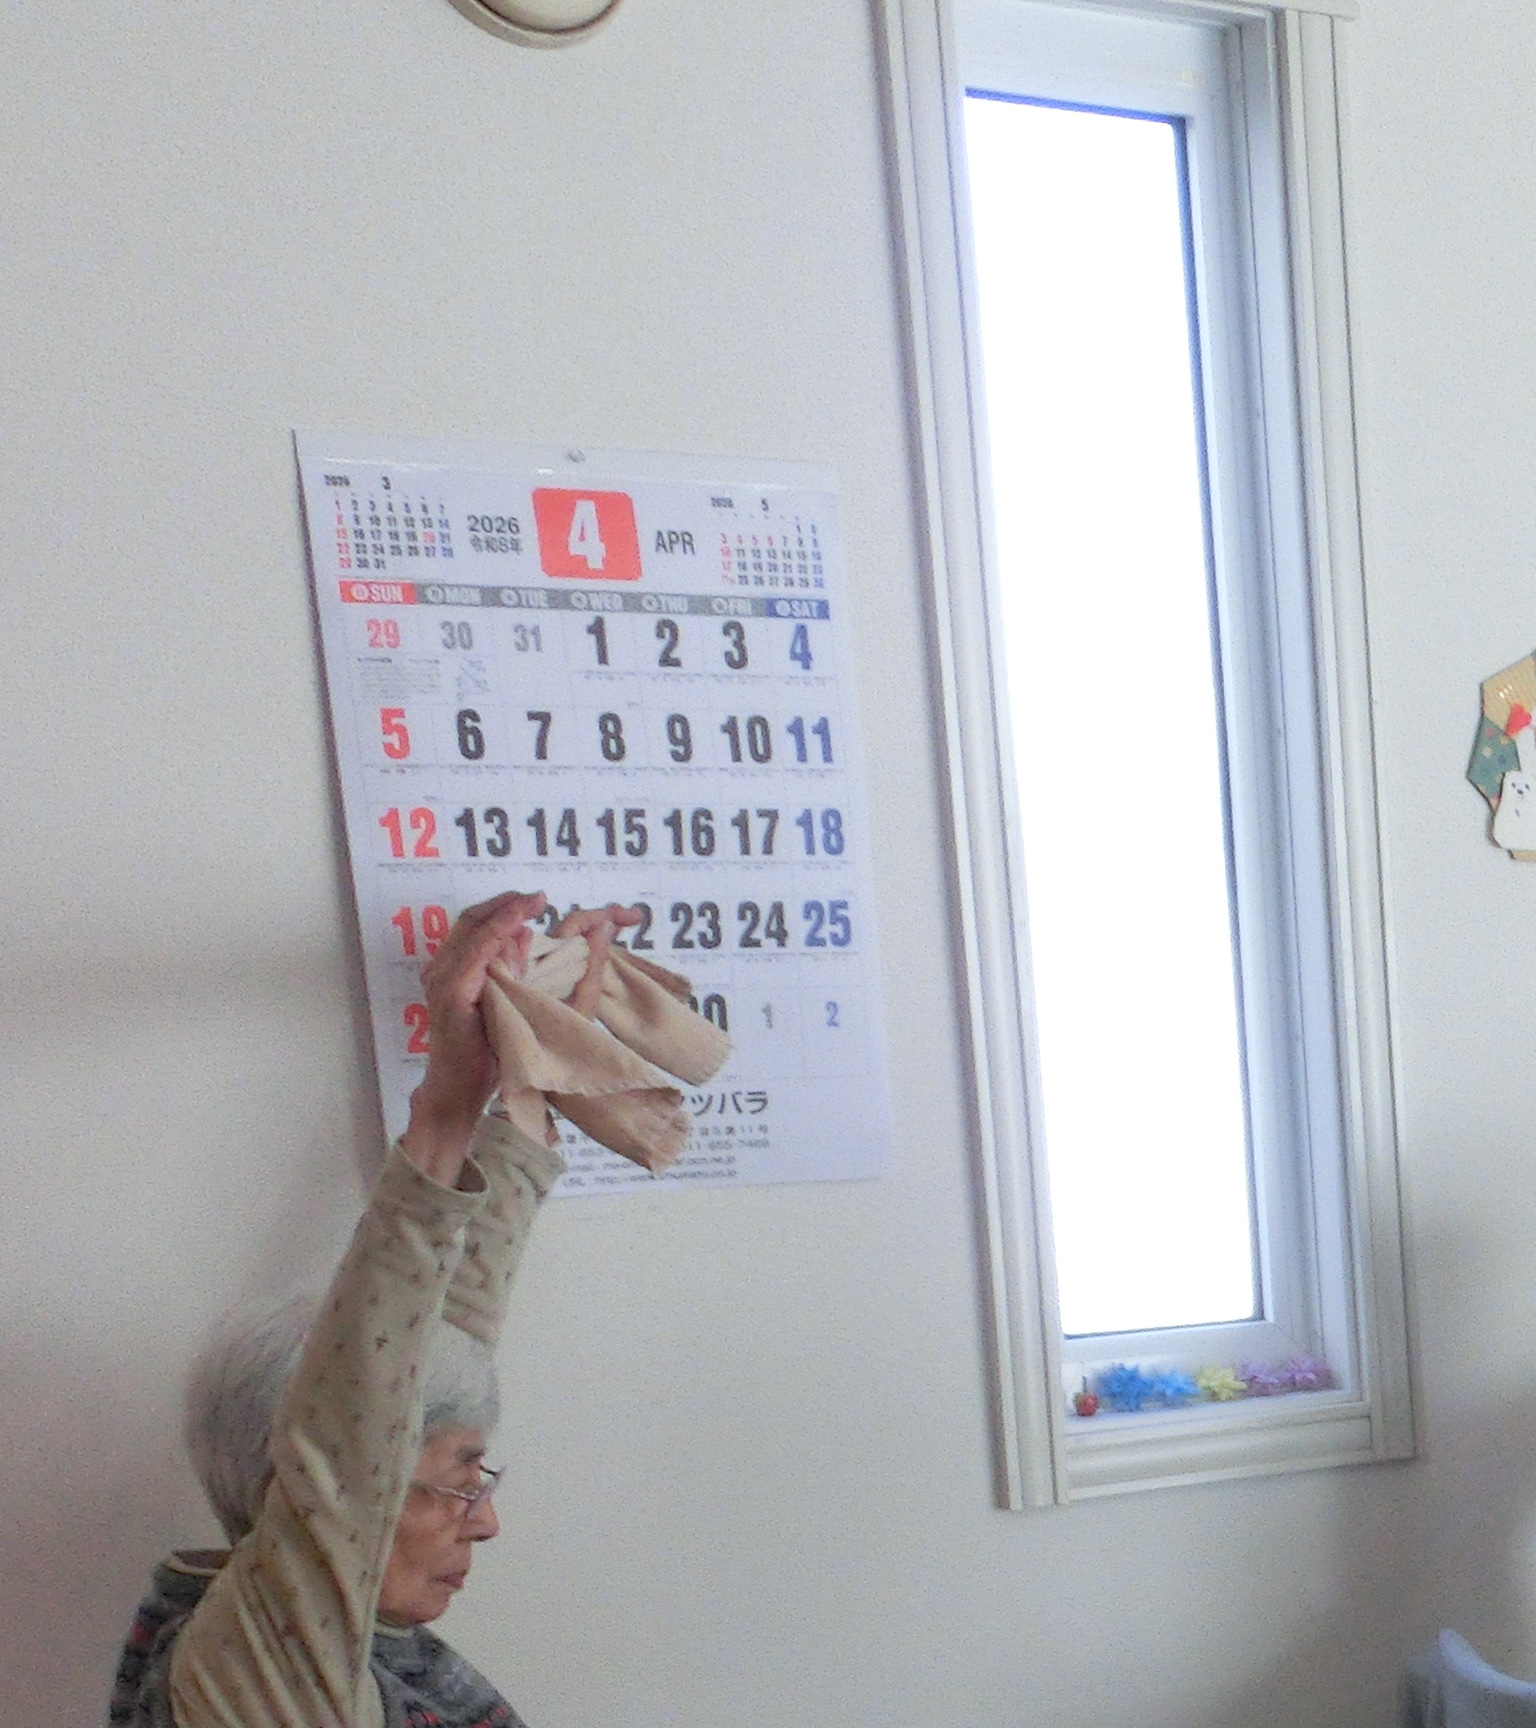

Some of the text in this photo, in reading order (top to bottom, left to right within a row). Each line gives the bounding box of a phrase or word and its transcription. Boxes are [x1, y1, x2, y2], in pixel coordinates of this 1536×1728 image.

[382, 476, 391, 490] 3
[466, 514, 520, 535] 2026
[567, 499, 607, 571] 4
[655, 530, 696, 555] APR
[370, 582, 402, 602] SUN
[366, 615, 812, 671] 29 30 31 1 2 3 4
[379, 706, 834, 765] 5 6 7 8 9 10 11
[378, 806, 847, 859] 12 13 14 15 16 17 18
[391, 904, 449, 956] 19
[669, 901, 722, 949] 23
[737, 900, 789, 949] 24
[802, 899, 853, 949] 25
[762, 1002, 773, 1029] 1
[825, 1000, 839, 1028] 2
[681, 1090, 769, 1117] ツバラ
